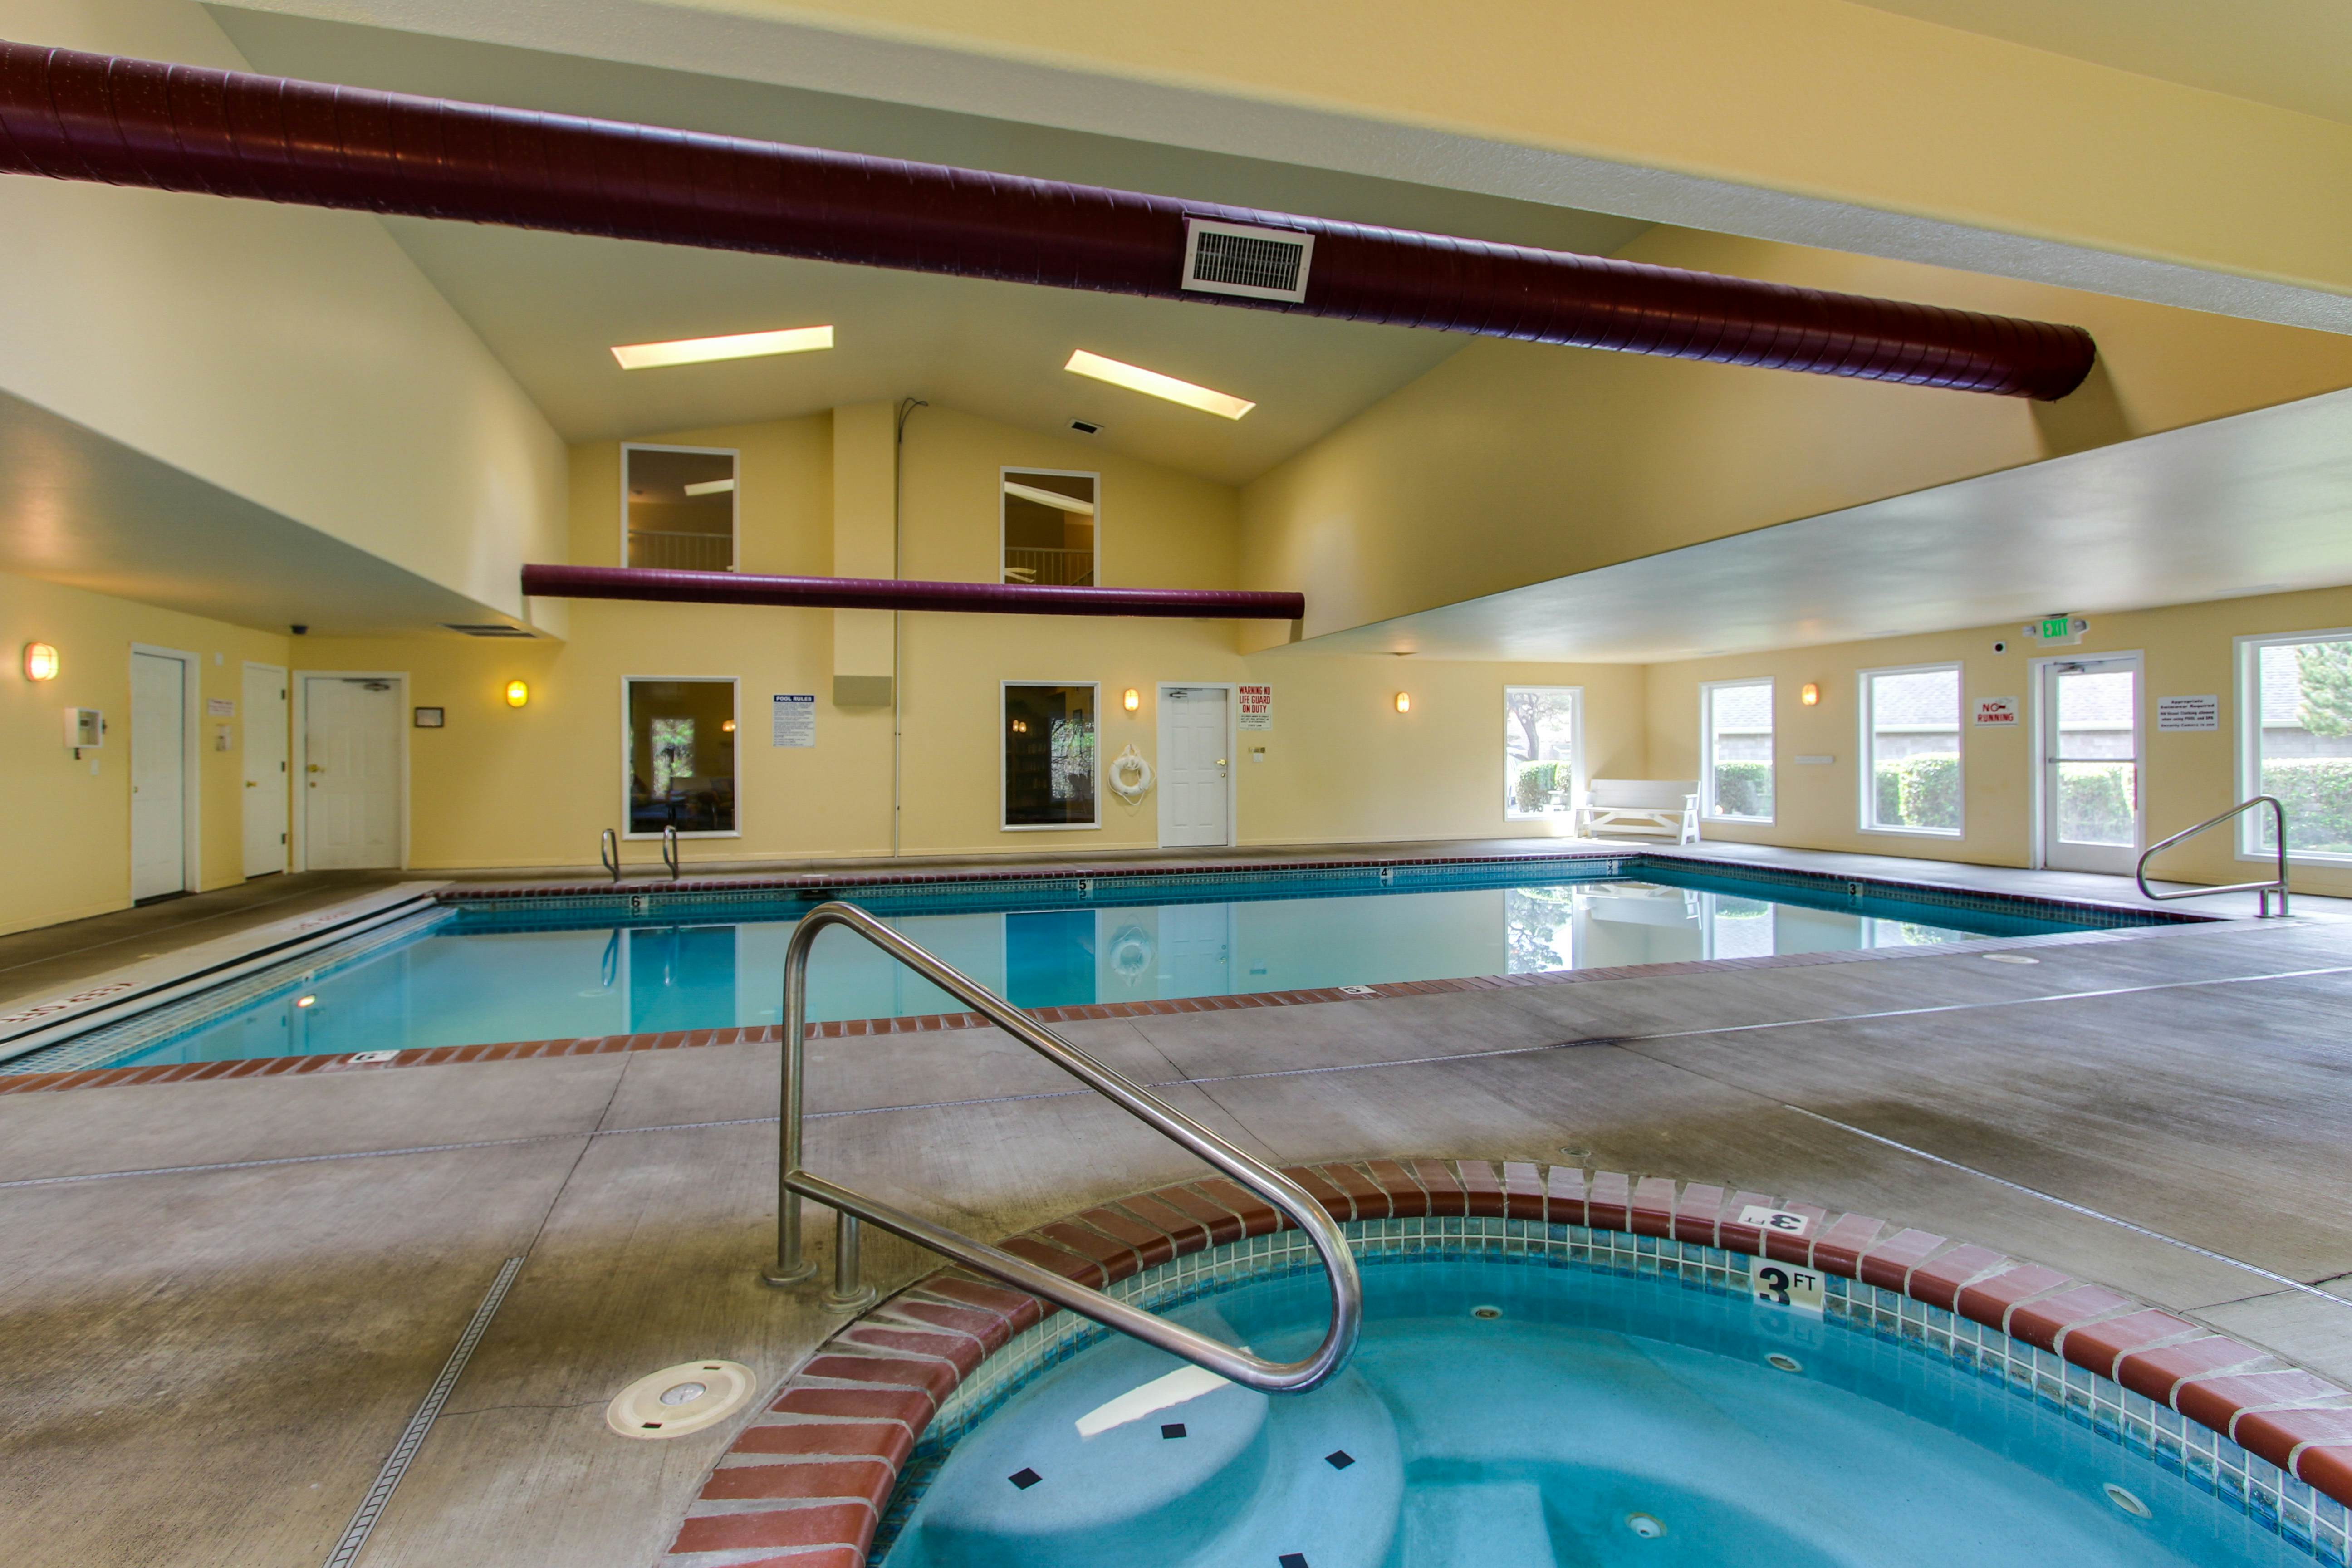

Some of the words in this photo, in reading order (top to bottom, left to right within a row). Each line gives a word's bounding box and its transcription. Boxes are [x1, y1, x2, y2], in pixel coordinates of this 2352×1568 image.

[2042, 618, 2068, 638] EXIT
[1239, 686, 1263, 695] WARNING
[1264, 686, 1270, 695] NO
[1239, 696, 1250, 704] LIFE
[1252, 696, 1270, 704] GUARD
[1243, 705, 1250, 713] ON
[1252, 705, 1267, 713] DUTY
[1977, 713, 2014, 722] RUNNING
[1607, 859, 1613, 868] 3
[1381, 867, 1387, 876] 4
[1079, 879, 1086, 890] 5
[1850, 883, 1856, 895] 3
[632, 896, 640, 906] 6
[1770, 1214, 1801, 1230] 3
[1759, 1267, 1791, 1306] 3
[1793, 1273, 1816, 1291] FT
